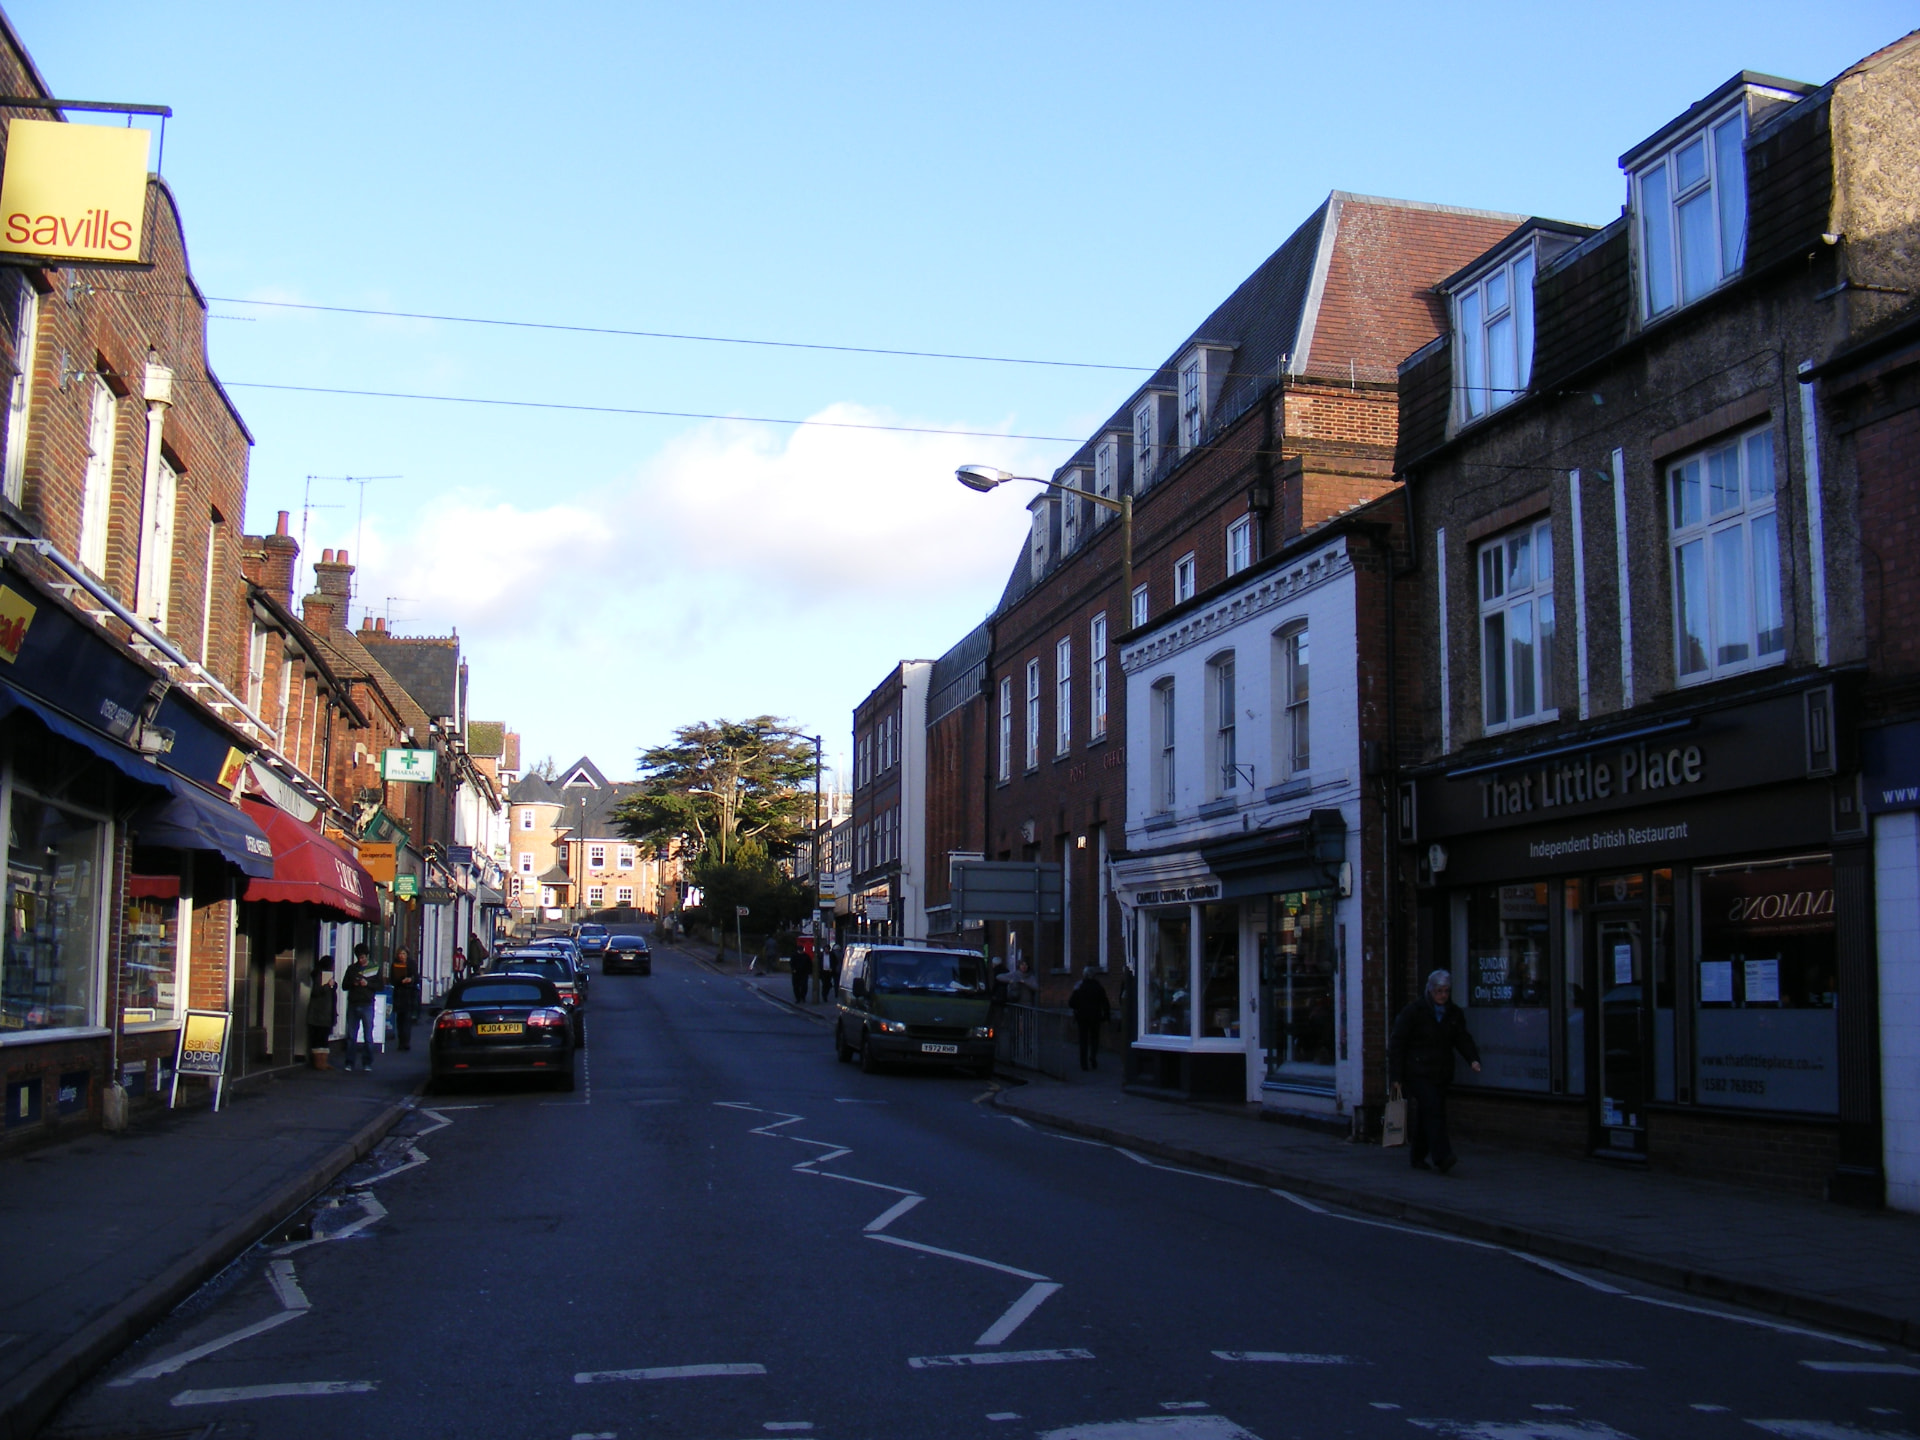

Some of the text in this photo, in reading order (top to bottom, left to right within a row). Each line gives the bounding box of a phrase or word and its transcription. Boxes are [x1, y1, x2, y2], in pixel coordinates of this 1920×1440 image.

[5, 209, 132, 251] savills
[391, 769, 426, 777] PHARMACY
[1070, 762, 1087, 783] POST
[1479, 742, 1702, 818] That Little Place
[1530, 821, 1688, 859] Independent British Restaurant
[1479, 957, 1508, 970] SUNDAY
[1482, 971, 1505, 984] ROAST
[1475, 986, 1491, 1002] Only
[480, 1024, 501, 1033] KJ04
[187, 1039, 220, 1051] savills
[184, 1050, 221, 1063] open
